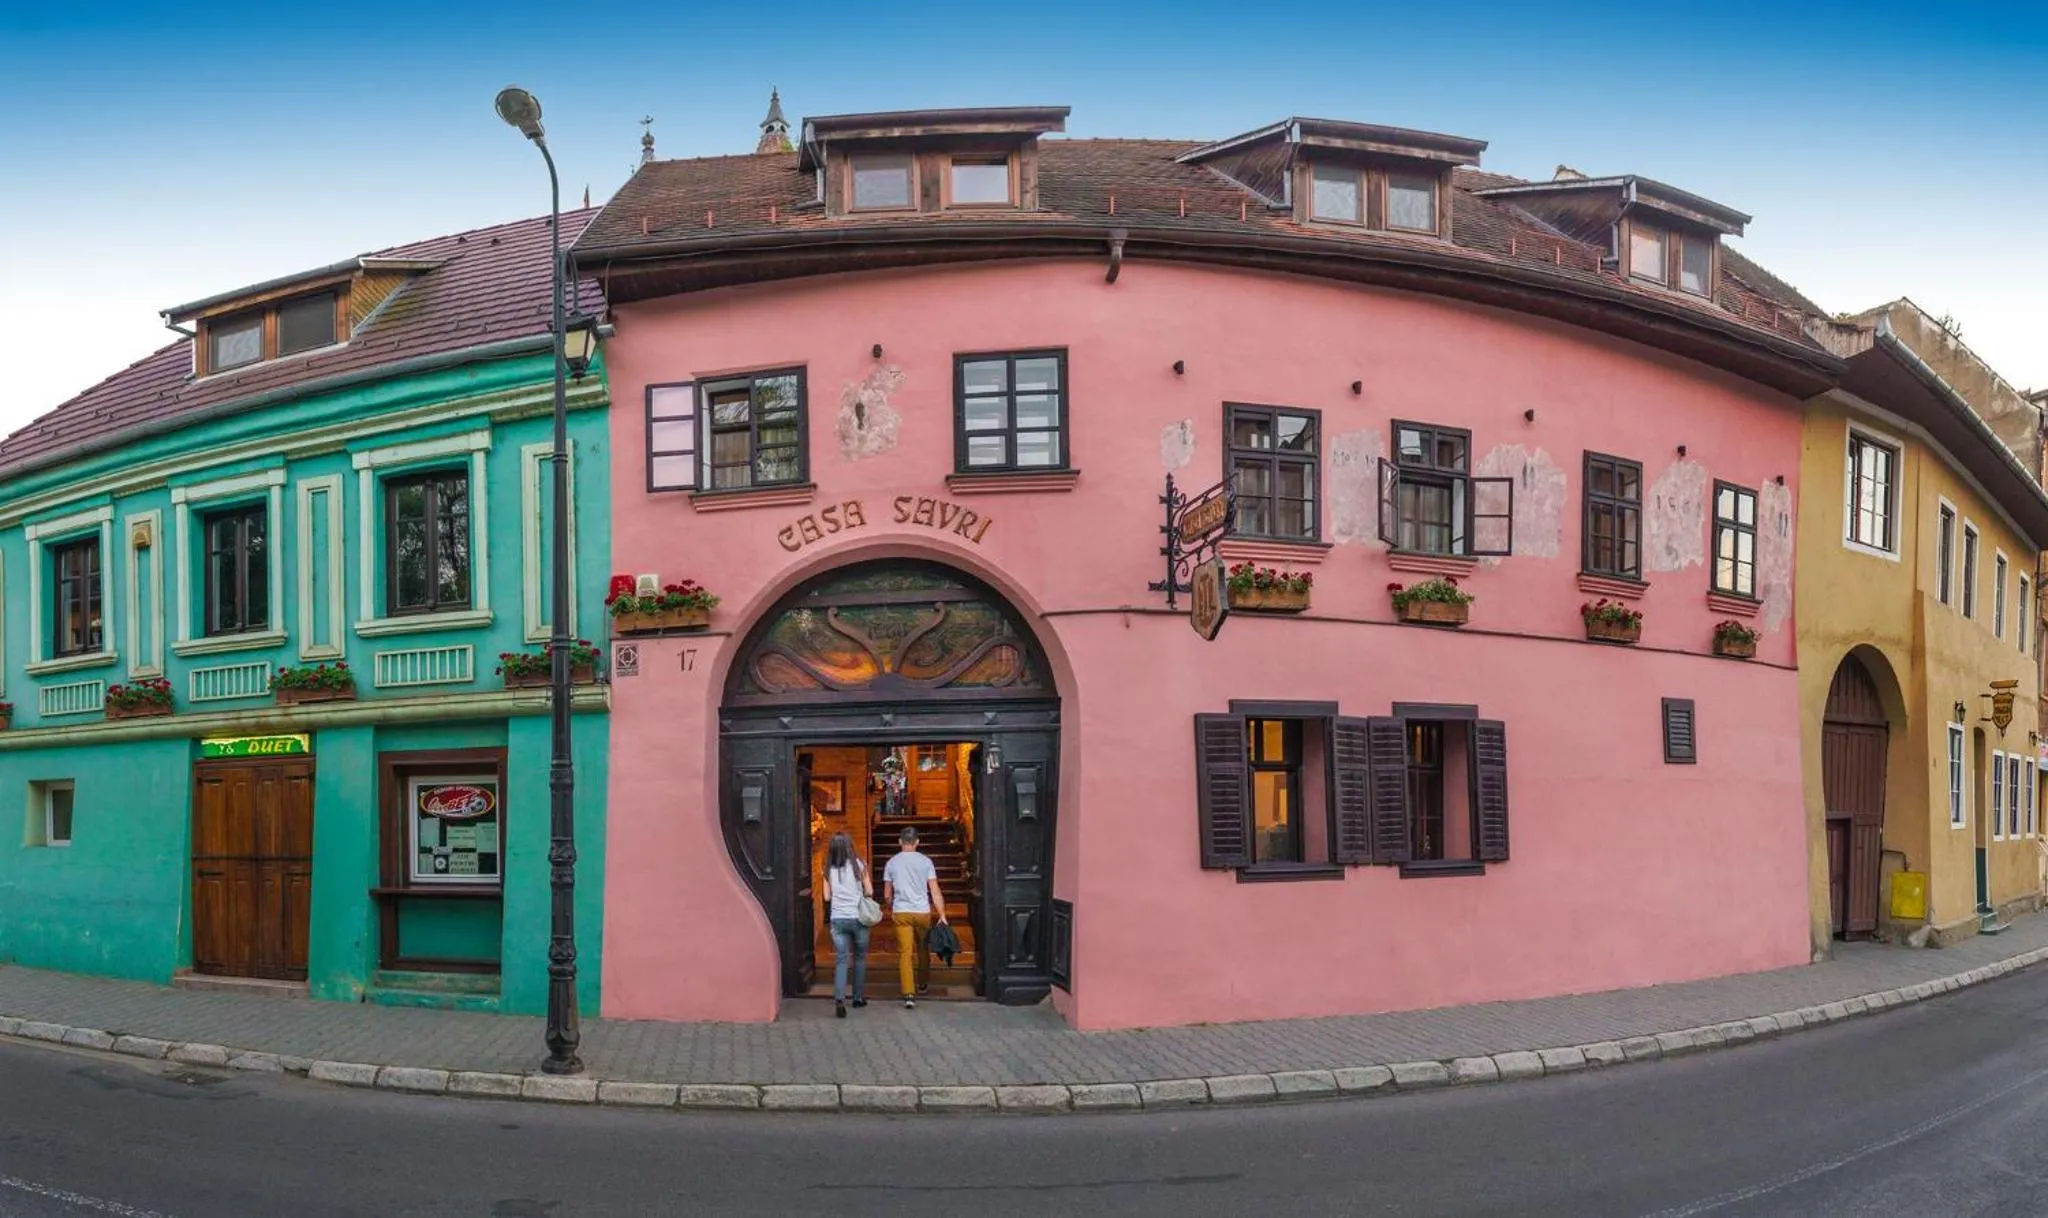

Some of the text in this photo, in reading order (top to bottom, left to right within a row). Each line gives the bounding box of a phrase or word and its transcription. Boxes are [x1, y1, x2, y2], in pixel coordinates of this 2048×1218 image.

[778, 497, 992, 552] CASA SAVRI
[677, 650, 697, 672] 17
[247, 739, 293, 754] DUET
